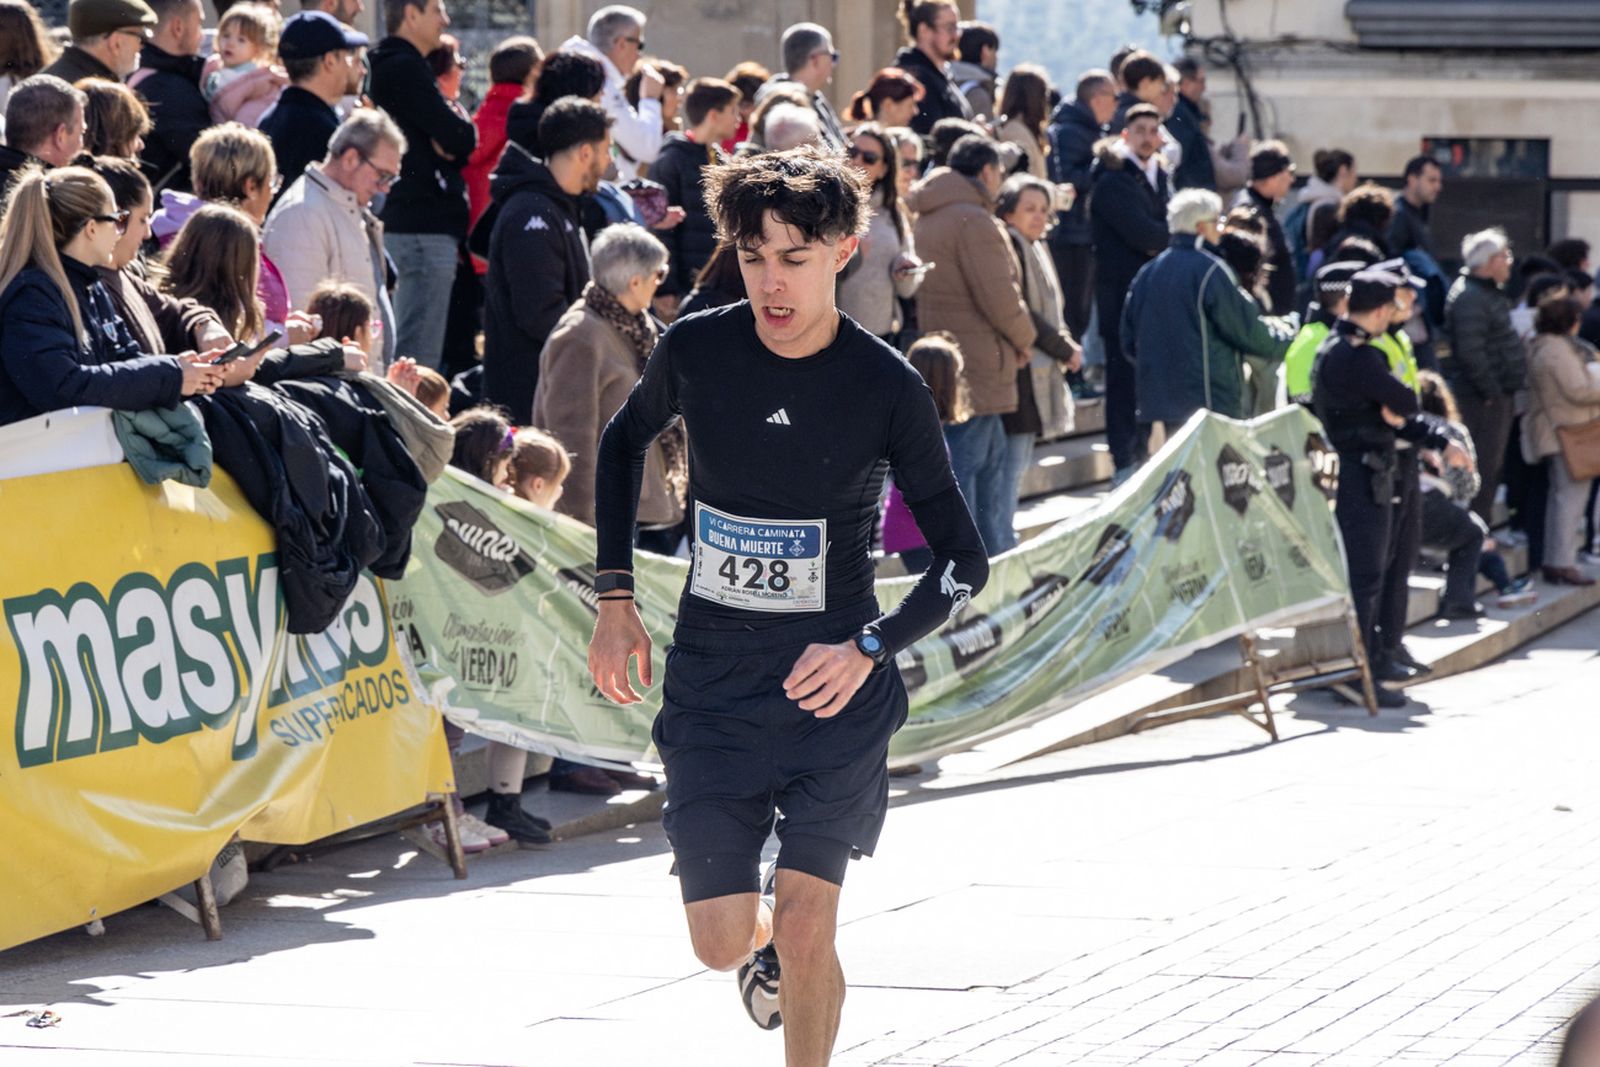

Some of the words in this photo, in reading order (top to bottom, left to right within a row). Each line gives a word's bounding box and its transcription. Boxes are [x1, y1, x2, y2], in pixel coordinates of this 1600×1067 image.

[709, 516, 717, 527] VI
[717, 520, 756, 536] CARRERA
[757, 528, 806, 538] CAMINATA
[708, 529, 738, 551] BUENA
[740, 538, 784, 555] MUERTE
[718, 555, 791, 593] 428
